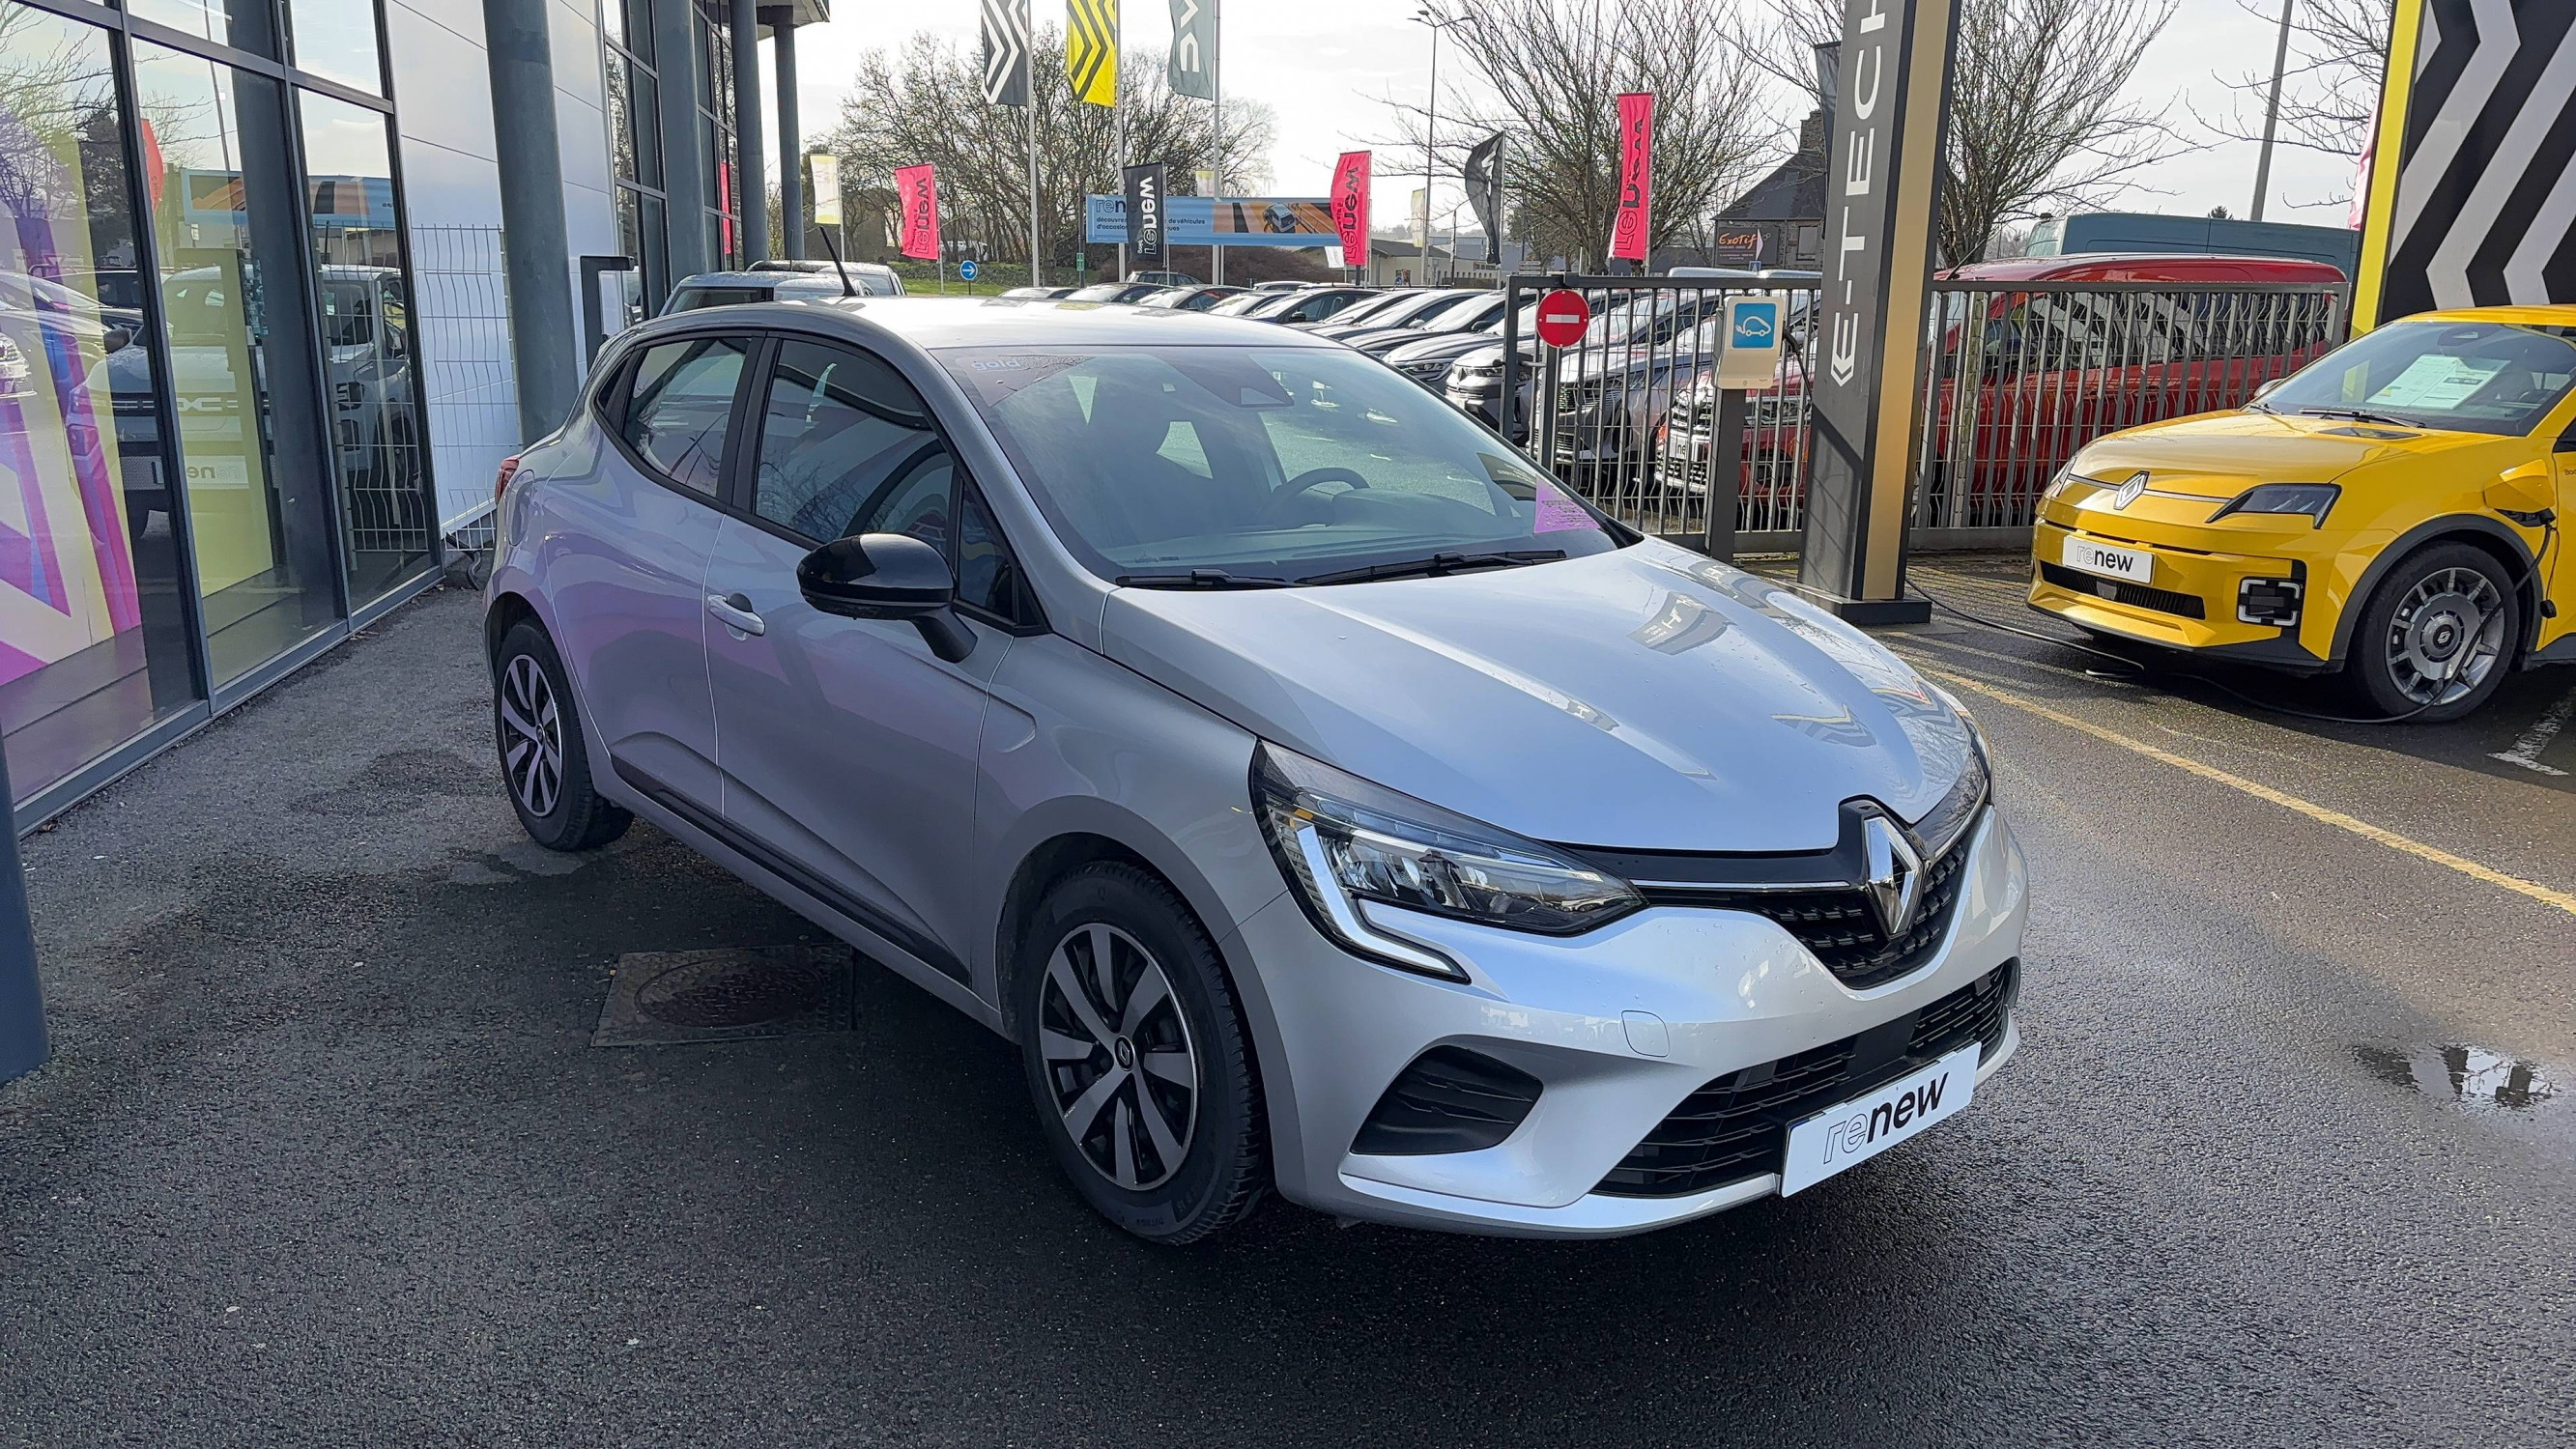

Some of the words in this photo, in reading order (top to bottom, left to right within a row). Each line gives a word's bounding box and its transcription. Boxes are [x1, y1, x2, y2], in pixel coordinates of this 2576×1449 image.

[971, 358, 1021, 371] gold
[2076, 545, 2133, 572] renew
[1823, 1071, 1950, 1165] renew
